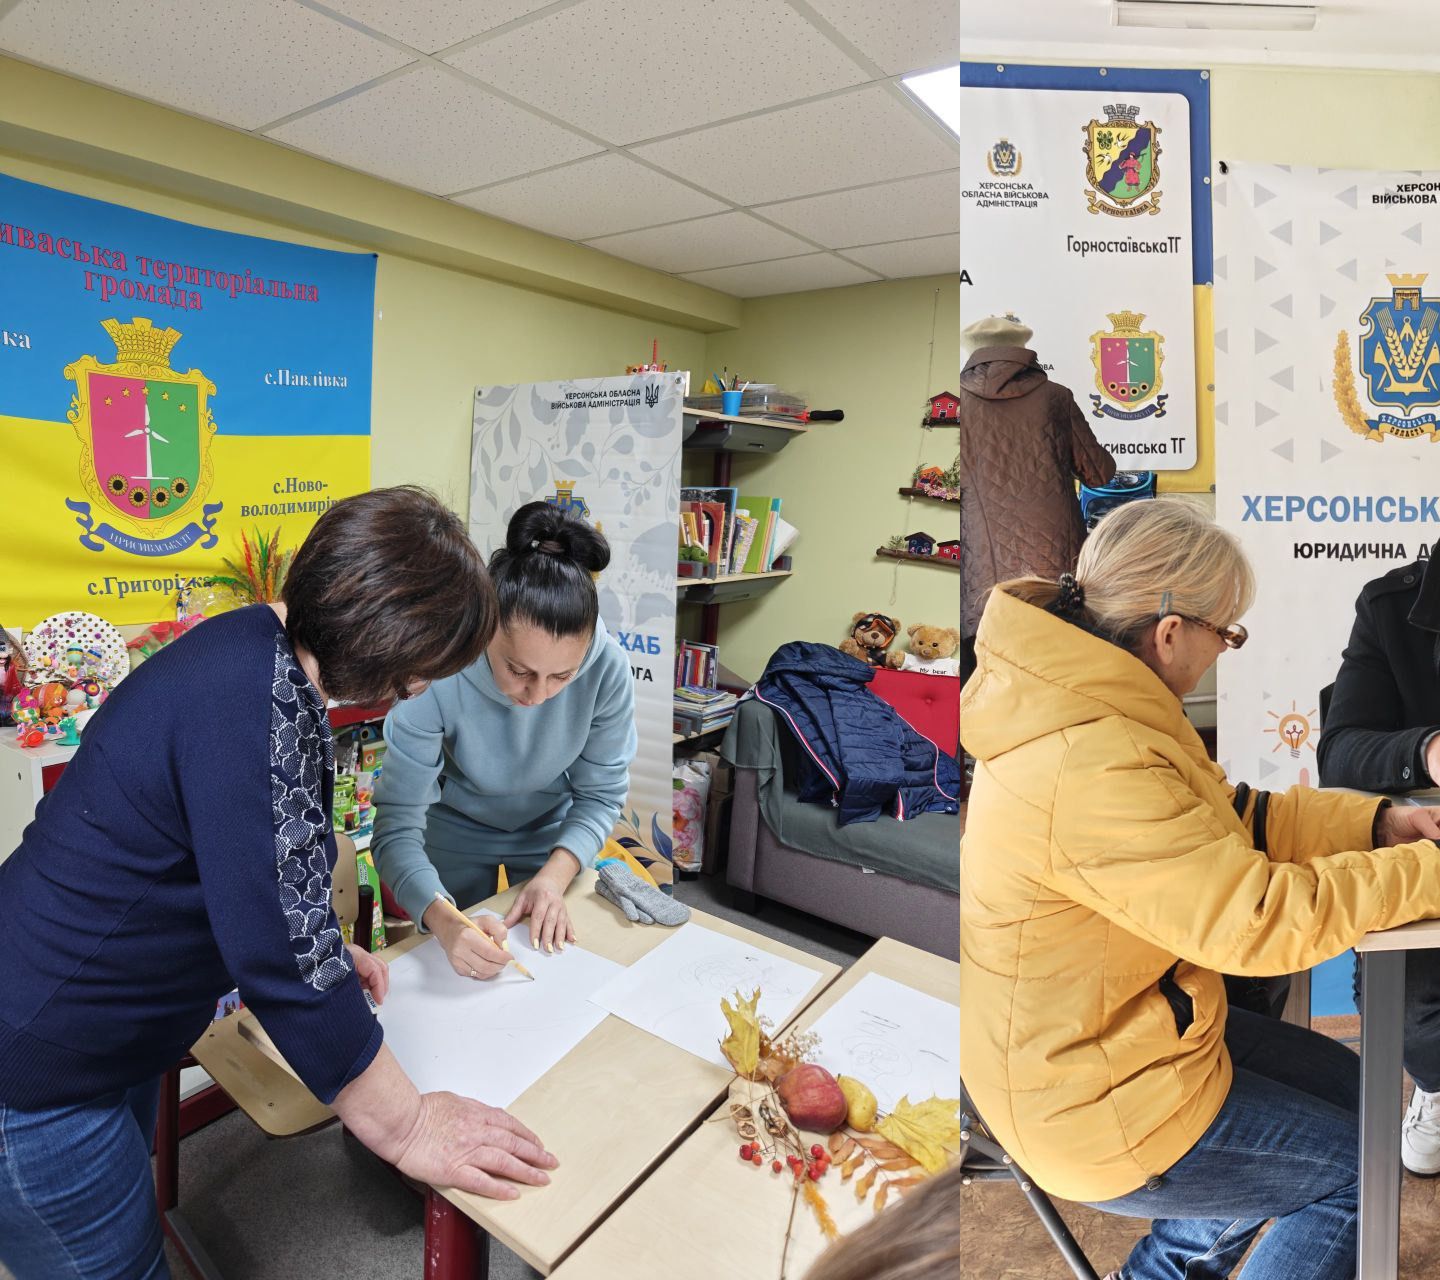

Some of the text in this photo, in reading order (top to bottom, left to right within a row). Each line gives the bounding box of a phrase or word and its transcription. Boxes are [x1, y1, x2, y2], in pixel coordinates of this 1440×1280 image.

[961, 190, 1049, 199] ОБЛАСНА ВІЙСЬКОВА
[979, 182, 1034, 190] ХЕРСОНСЬКА
[976, 200, 1038, 208] АДМІНІСТРАЦІЯ
[1372, 193, 1437, 204] ВІЙСЬКОВА
[136, 255, 319, 302] територіальна
[84, 270, 203, 311] громада
[264, 369, 348, 387] с.Павлівка
[565, 389, 640, 400] ХЕРСОНСЬКА ОБЛАСНА
[551, 399, 640, 409] ВІЙСЬКОВА АДМІНІСТРАЦІЯ
[1103, 437, 1186, 454] сиваська ТГ
[273, 477, 328, 494] с.Ново-
[1294, 543, 1407, 562] ЮРИДИЧНА
[618, 631, 661, 655] ХАБ
